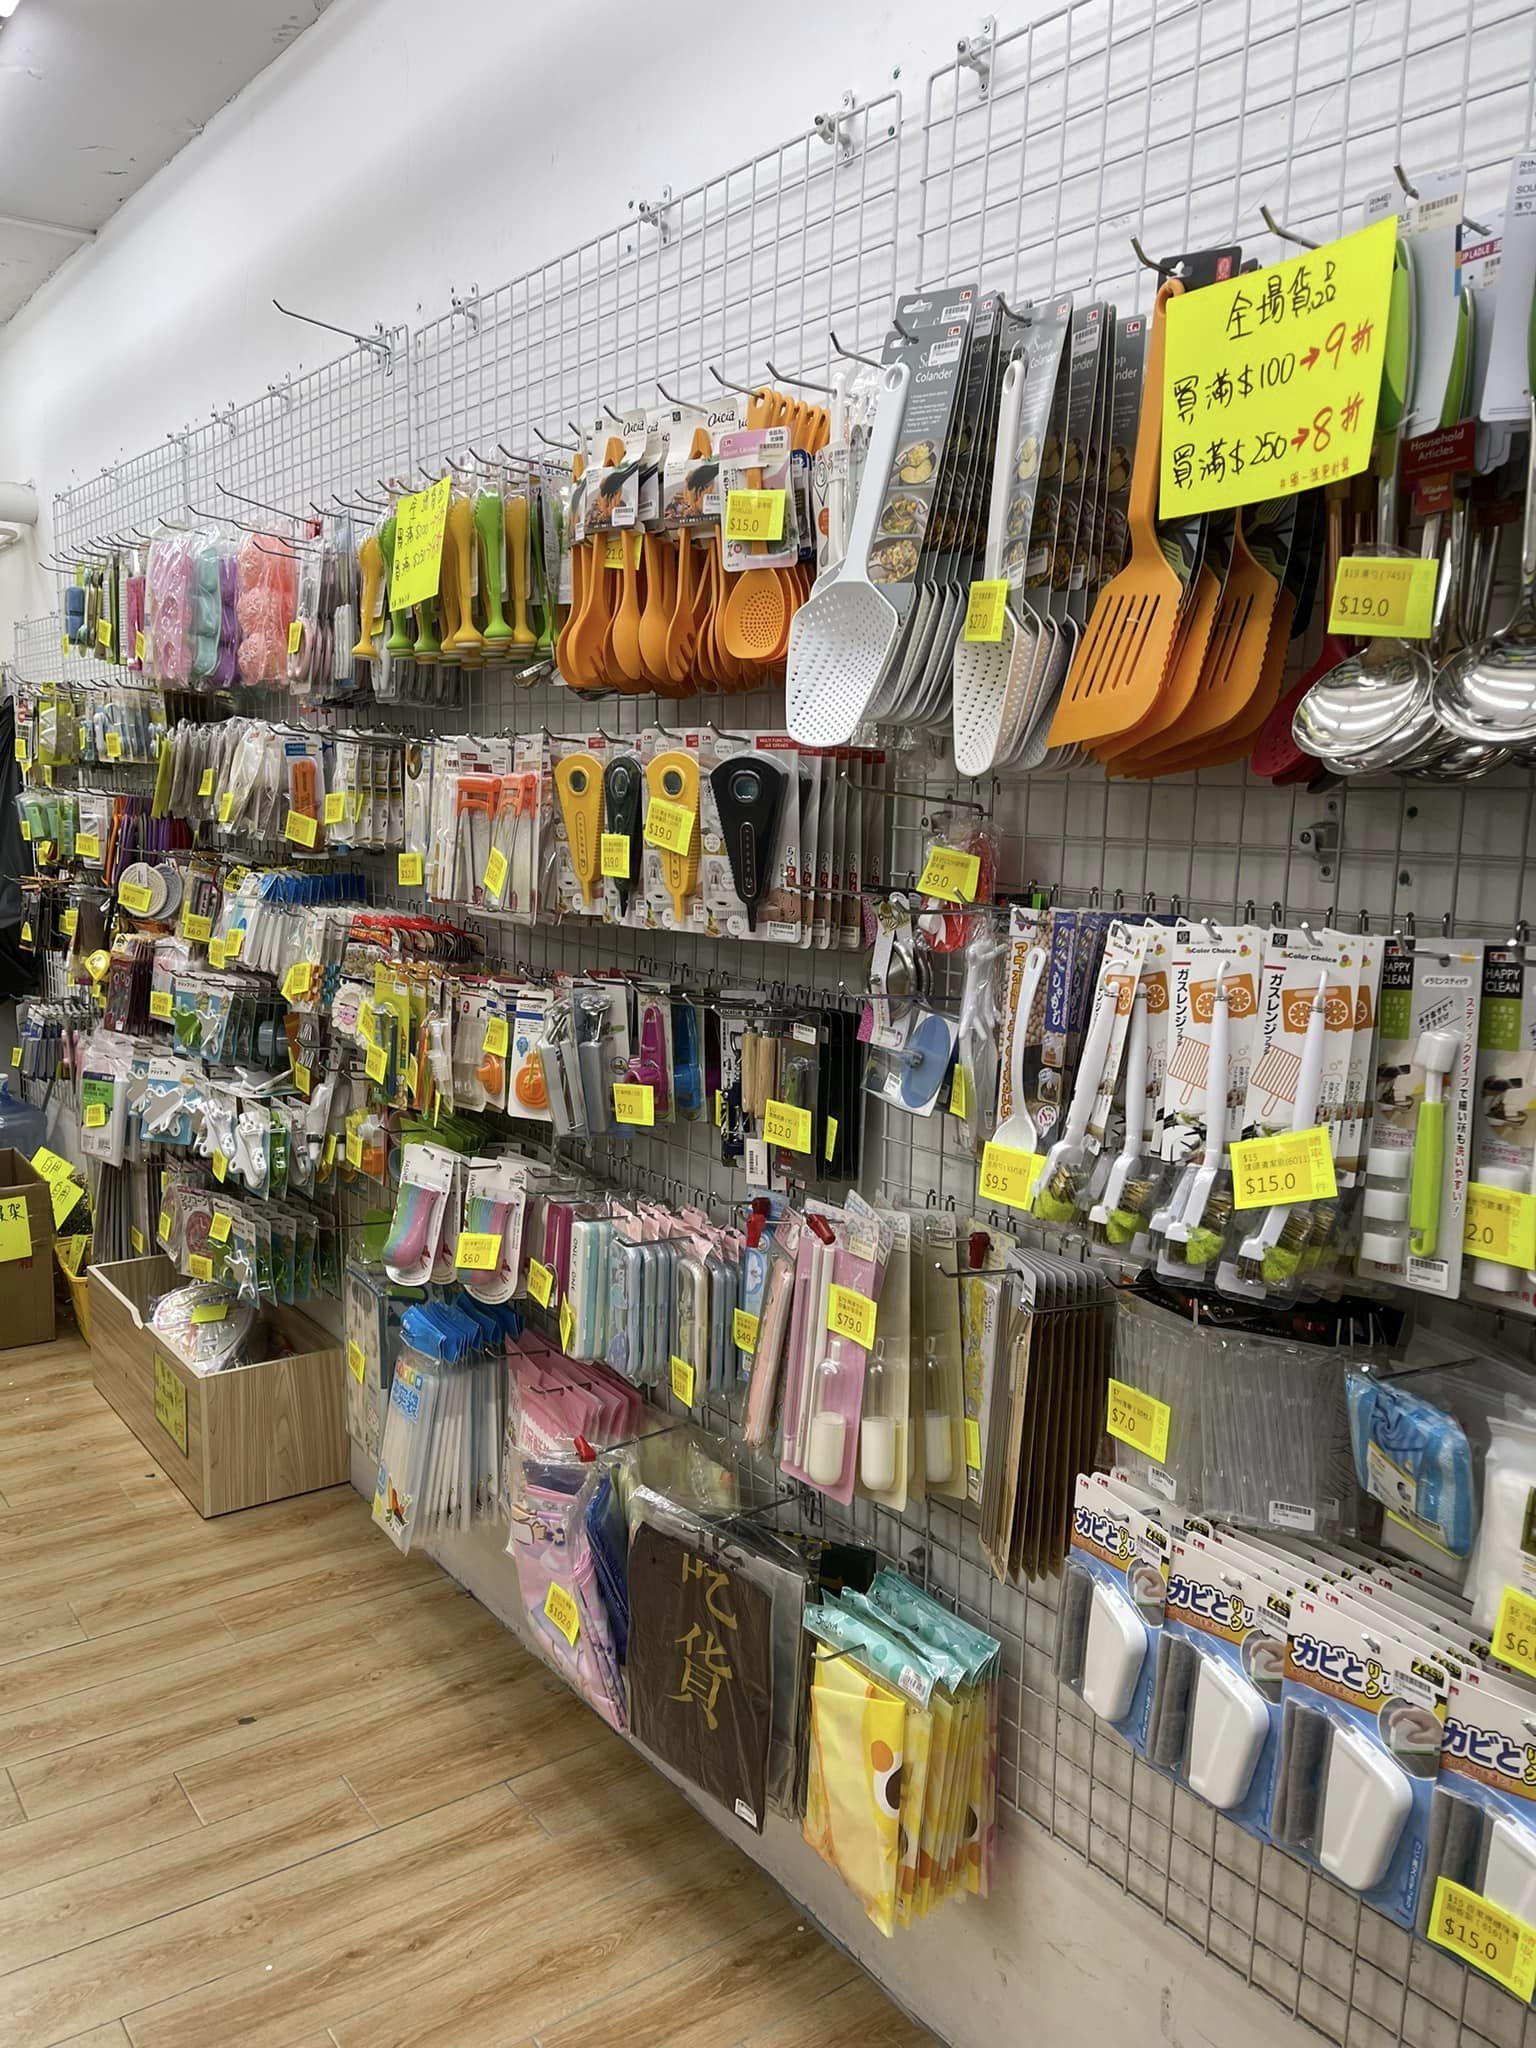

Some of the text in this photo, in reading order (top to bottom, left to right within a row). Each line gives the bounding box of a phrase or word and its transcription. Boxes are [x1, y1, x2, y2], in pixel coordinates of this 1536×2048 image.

[1226, 260, 1336, 341] 全場貨品
[915, 369, 953, 384] Colander
[1410, 428, 1465, 451] Household
[1418, 445, 1454, 462] Articles
[730, 519, 759, 533] $15.0
[1338, 595, 1390, 617] $19.0
[969, 613, 988, 629] $27.0
[649, 822, 672, 841] $19.0
[603, 857, 619, 868] $19.0
[926, 872, 949, 888] $9.0
[1287, 952, 1337, 963] Color Choice
[1486, 968, 1521, 980] HAPPY
[1485, 982, 1521, 993] CLEAN
[1051, 971, 1063, 1027] しゃもじ
[618, 1104, 633, 1114] $7.0
[767, 1121, 791, 1139] $12.0
[1243, 1153, 1258, 1163] $15
[985, 1172, 1009, 1192] $9.5
[1246, 1172, 1296, 1195] $15.0
[837, 1312, 862, 1333] $79.0
[1112, 1408, 1136, 1432] $7.0
[1504, 1631, 1536, 1661] $6.
[1443, 1917, 1497, 1961] $15.0
